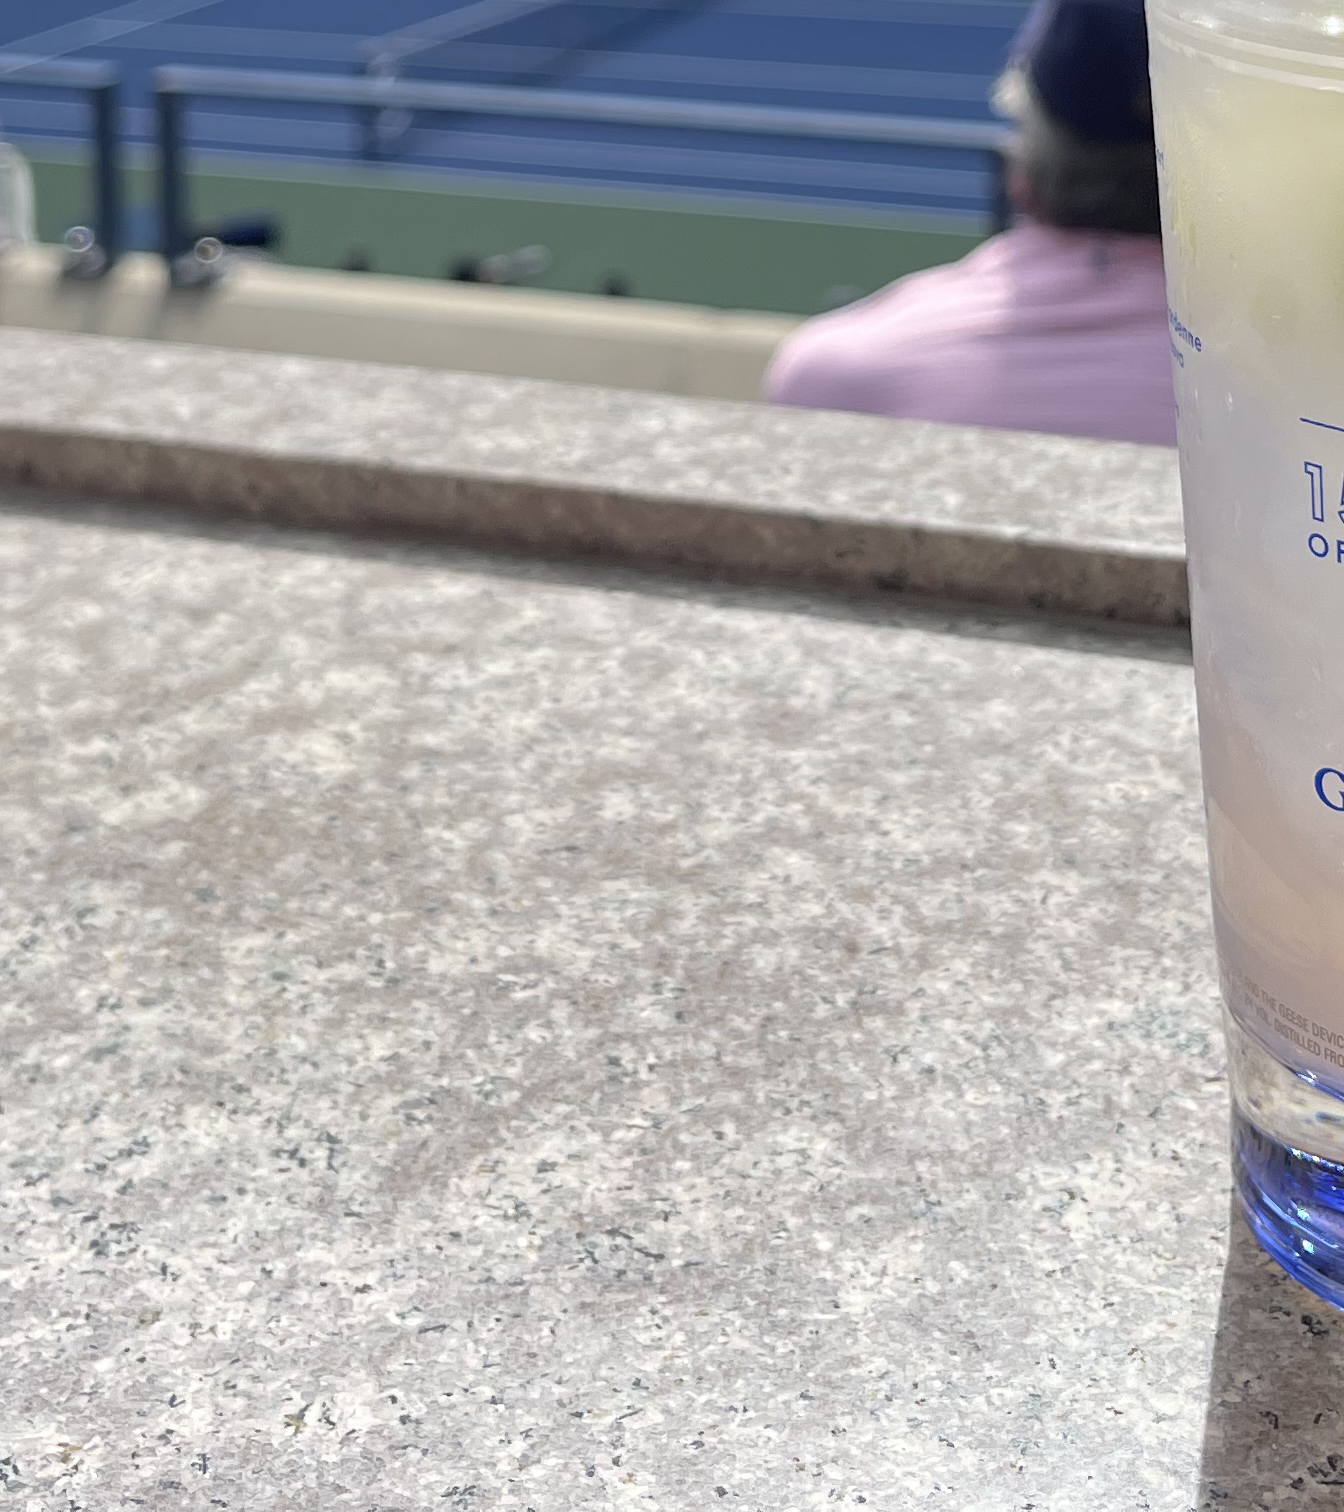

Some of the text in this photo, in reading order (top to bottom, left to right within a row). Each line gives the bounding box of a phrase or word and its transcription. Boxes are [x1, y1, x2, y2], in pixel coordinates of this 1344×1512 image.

[1260, 988, 1276, 1014] THE
[1279, 1003, 1309, 1032] GEESE
[1274, 1018, 1320, 1056] DISTILLED
